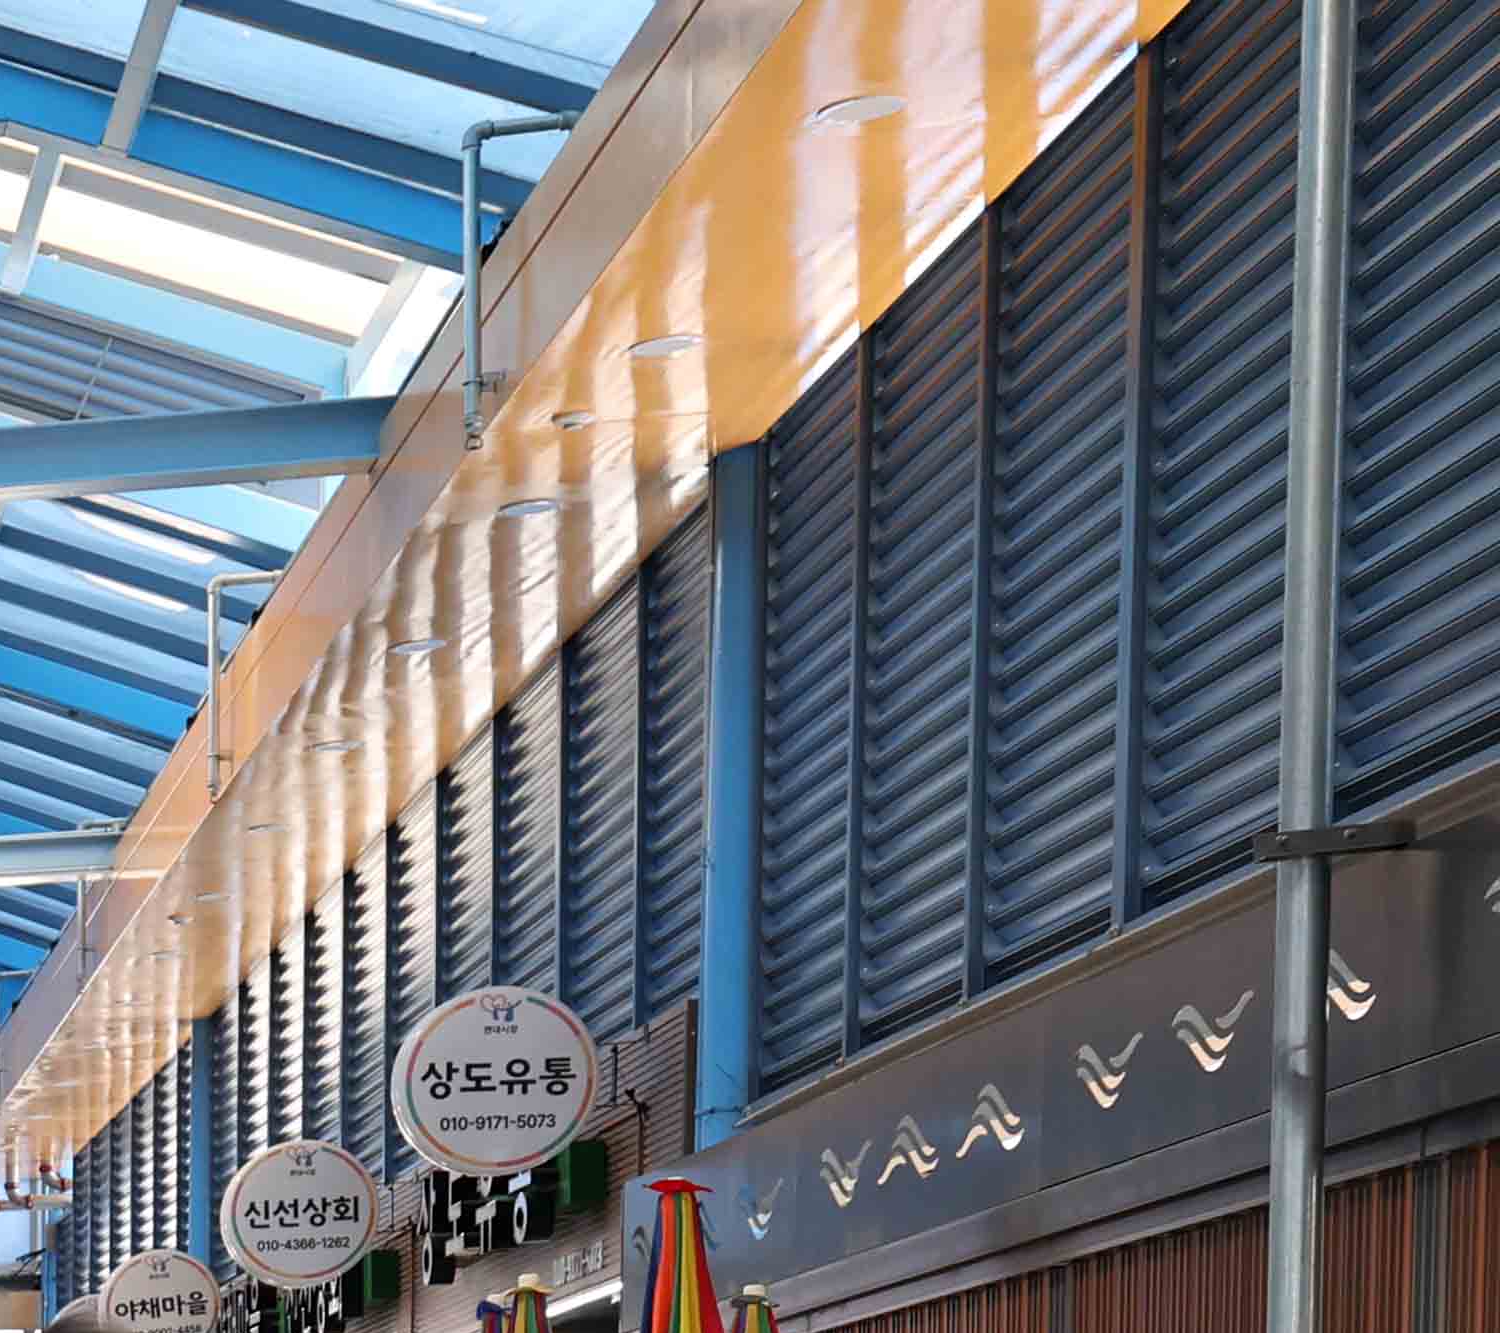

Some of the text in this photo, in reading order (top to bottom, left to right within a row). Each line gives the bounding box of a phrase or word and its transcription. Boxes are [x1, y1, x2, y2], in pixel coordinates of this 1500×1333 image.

[420, 1057, 577, 1100] 상도유통
[440, 1114, 556, 1131] 010-9171-5073
[244, 1196, 359, 1229] 신선상회
[115, 1291, 208, 1321] 야채마을
